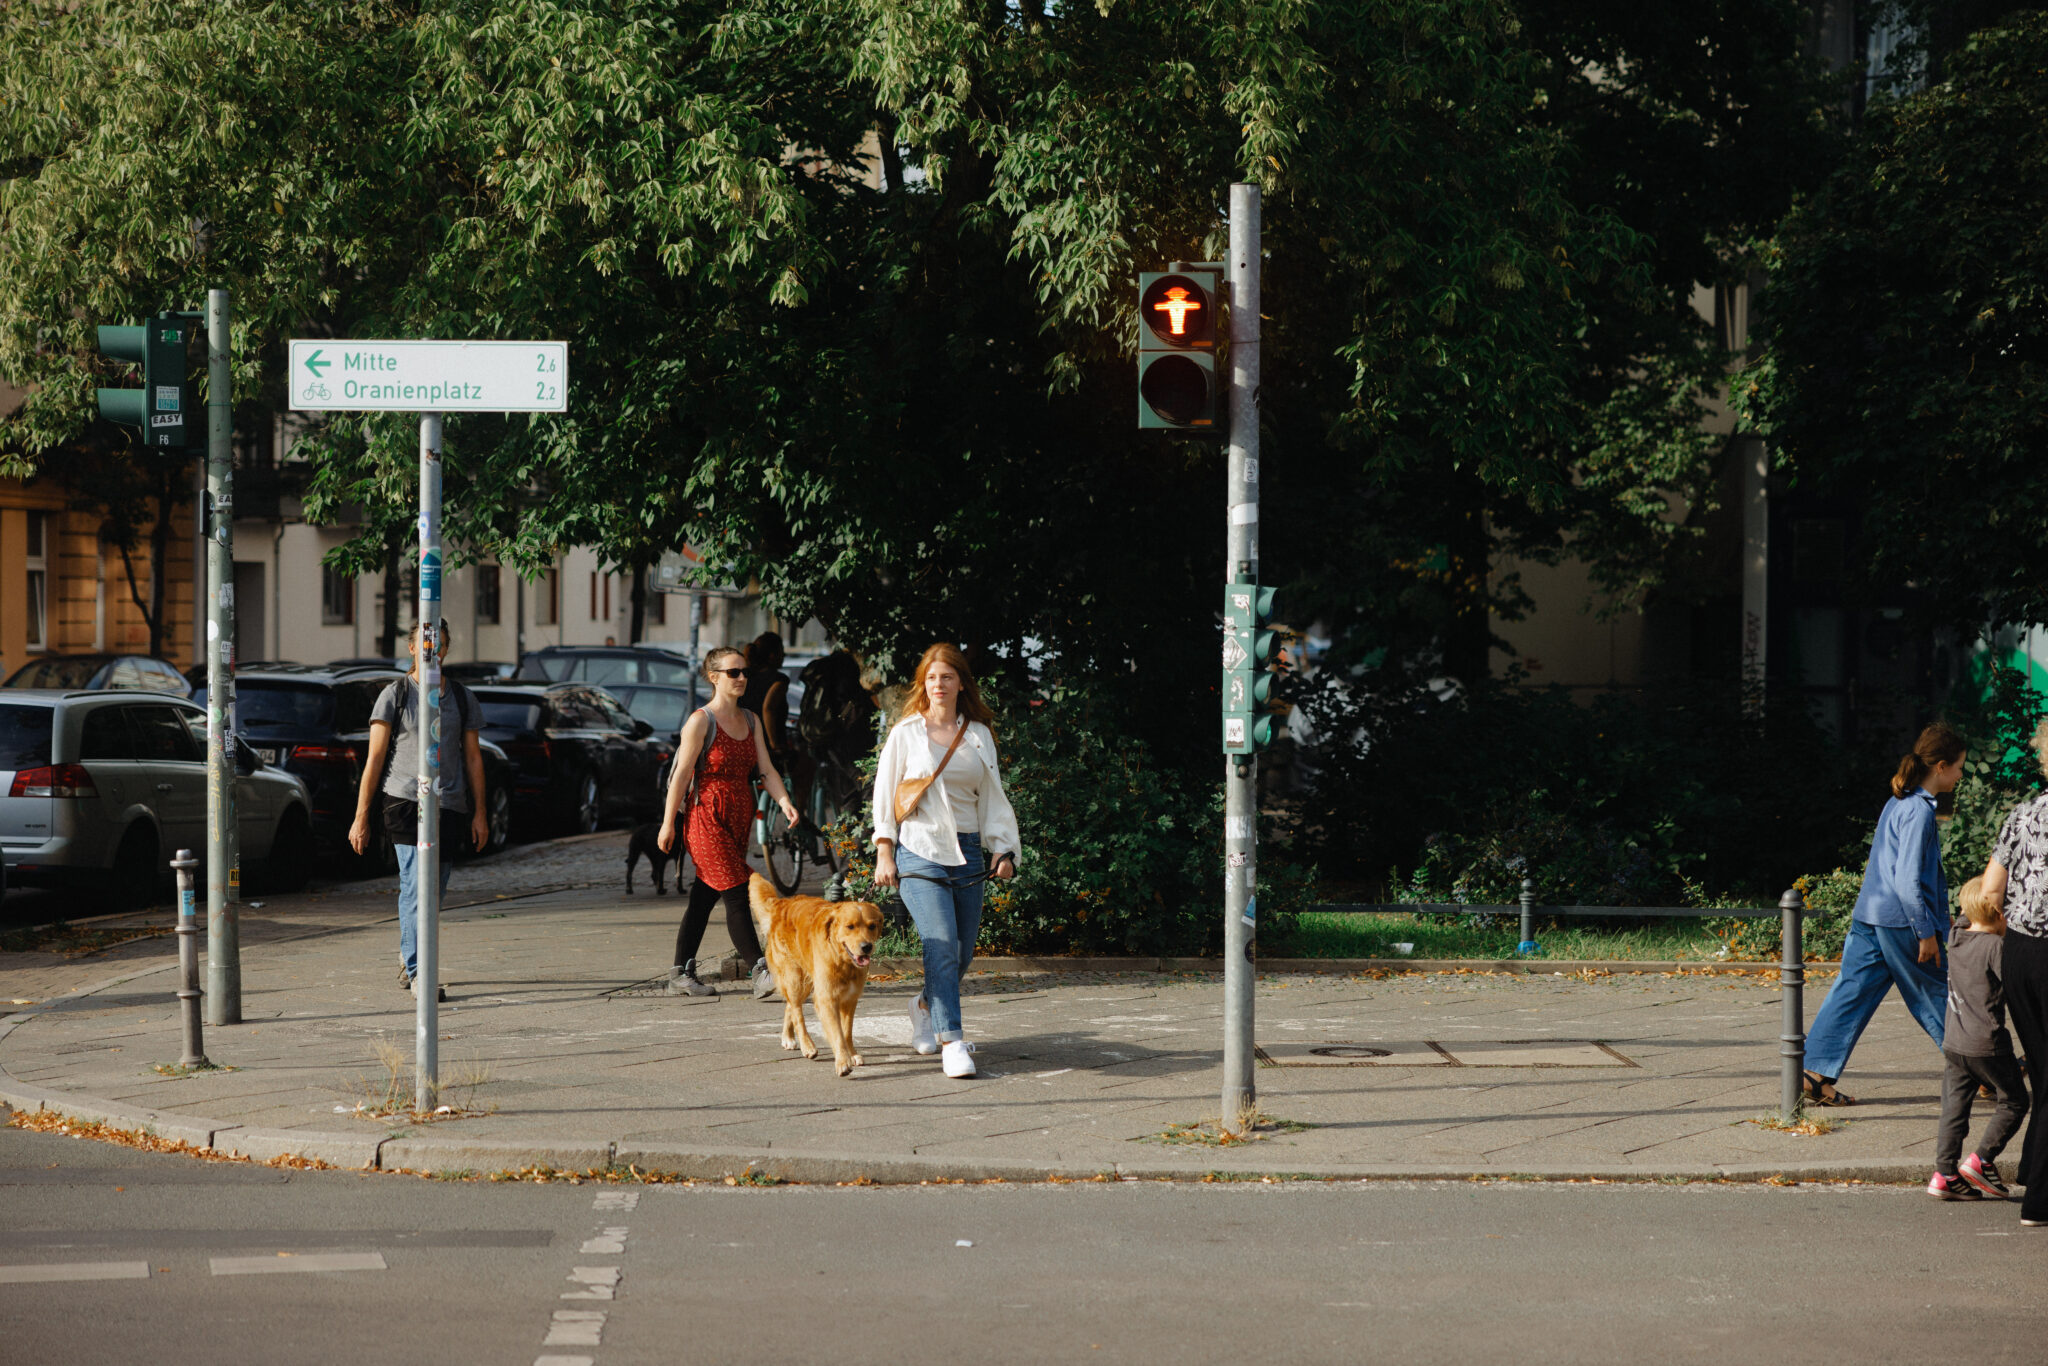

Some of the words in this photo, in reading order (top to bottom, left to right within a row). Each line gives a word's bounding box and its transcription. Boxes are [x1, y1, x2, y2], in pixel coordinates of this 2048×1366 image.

[344, 352, 397, 371] Mitte
[344, 380, 482, 404] Oranienplatz
[153, 415, 181, 424] EASY
[159, 434, 169, 445] F6
